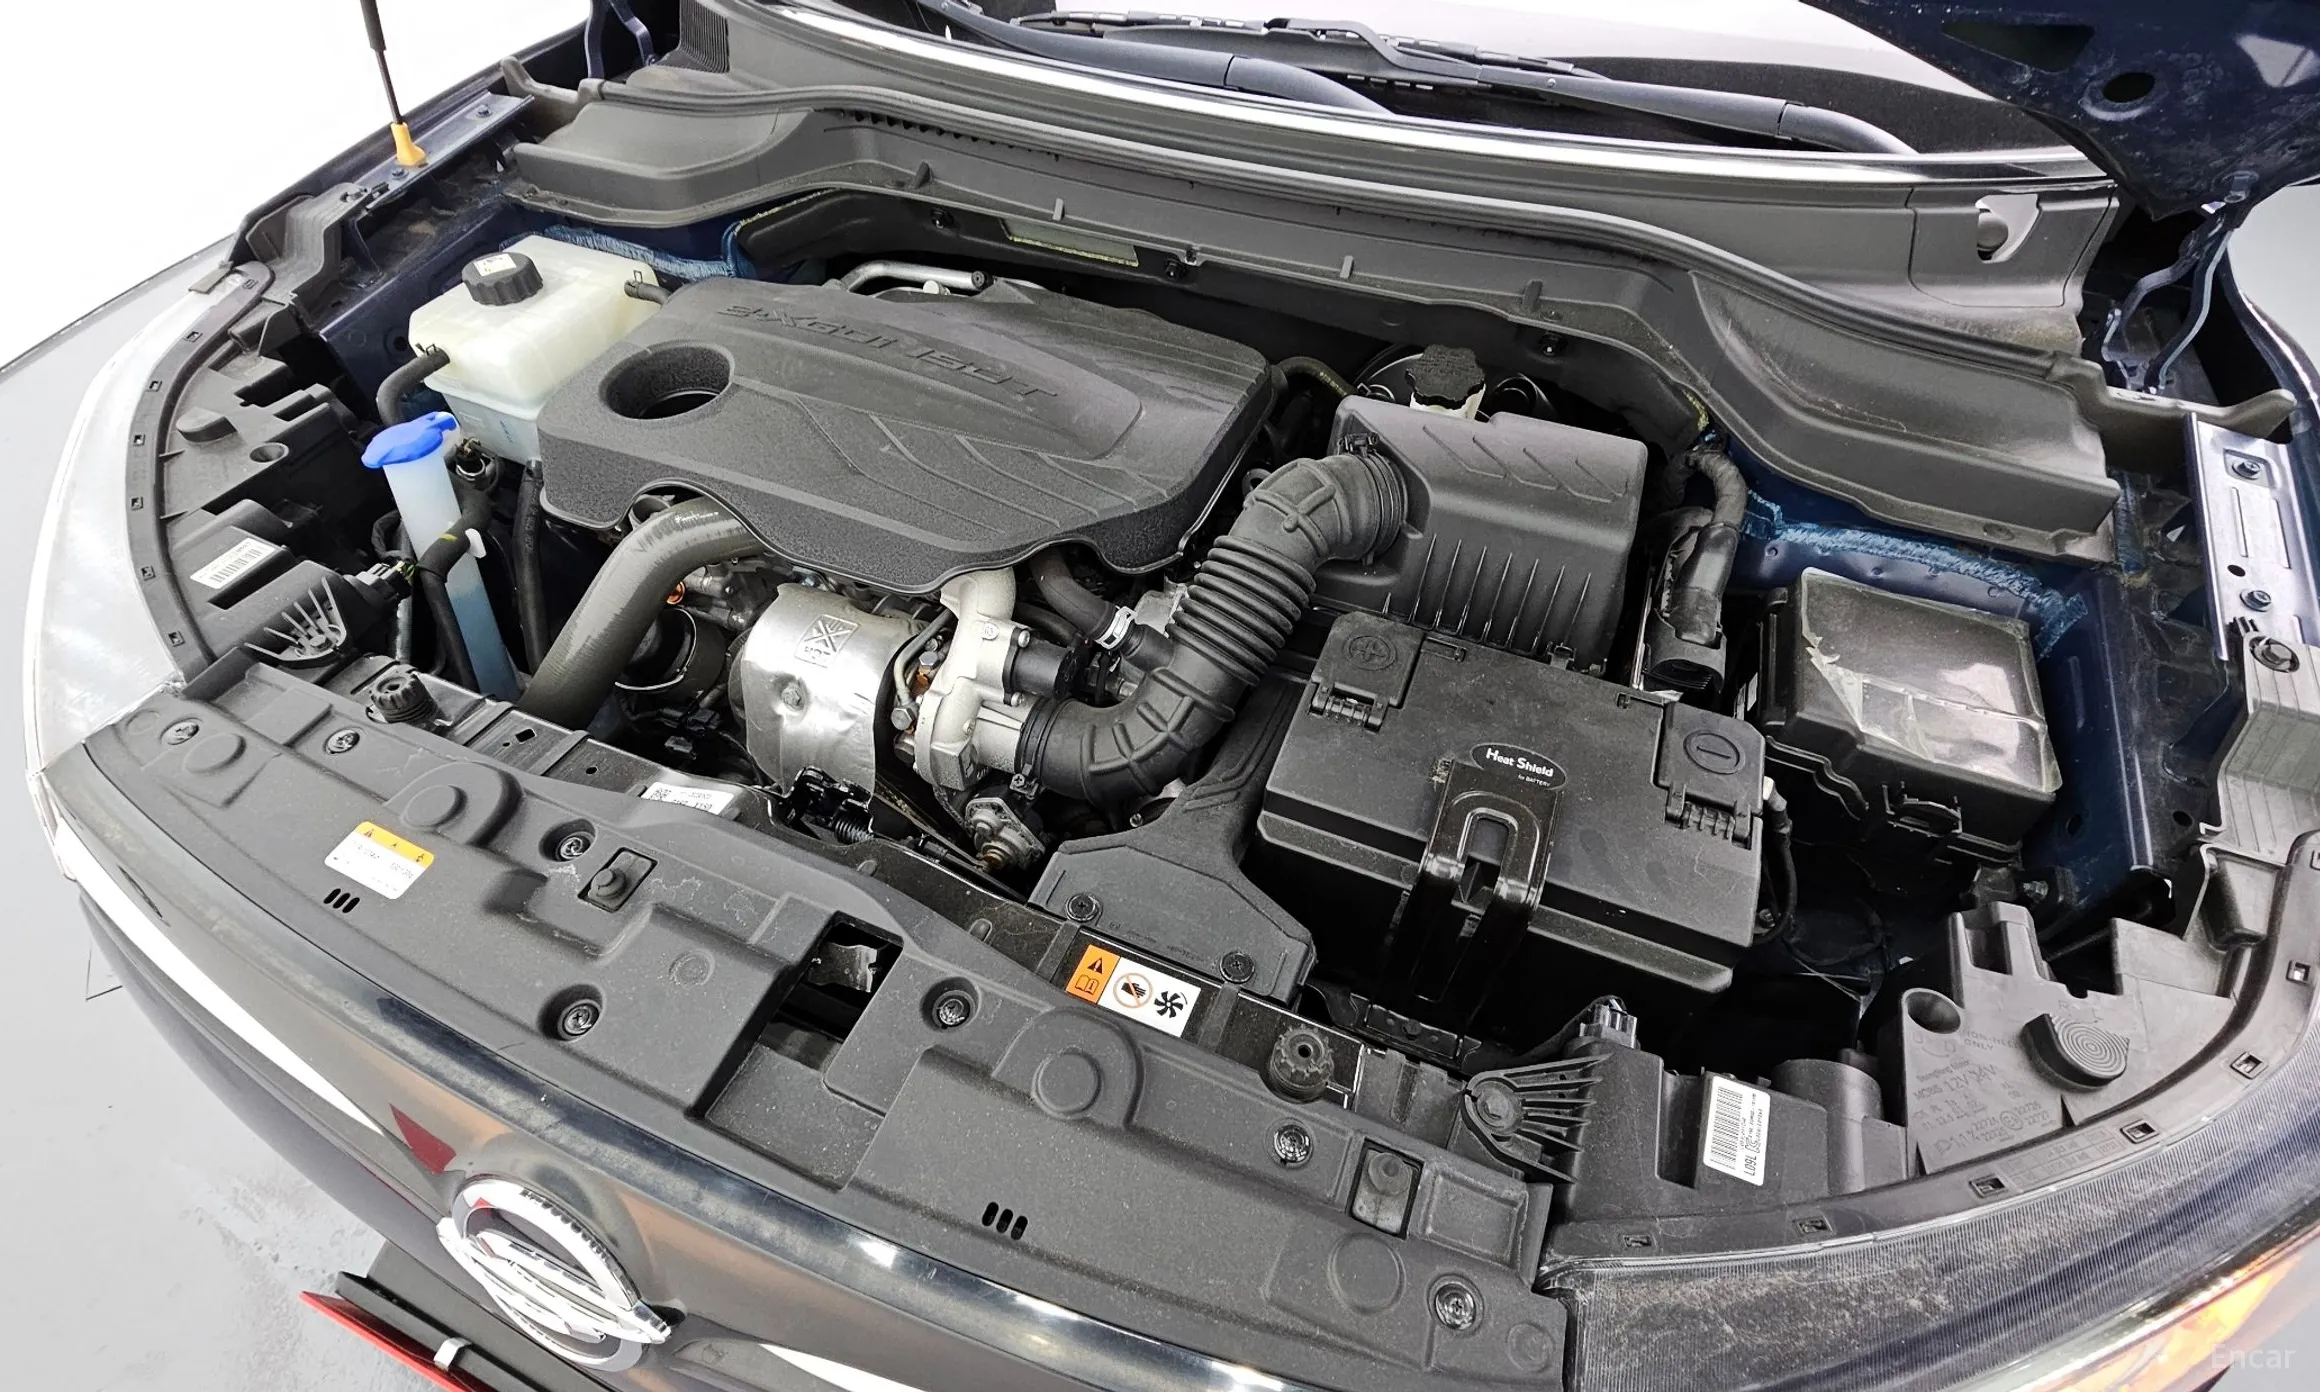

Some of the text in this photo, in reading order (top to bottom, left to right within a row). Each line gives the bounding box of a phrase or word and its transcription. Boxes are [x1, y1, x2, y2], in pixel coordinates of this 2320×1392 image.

[1485, 748, 1554, 777] Heat Shield
[1944, 1073, 1969, 1092] 12V
